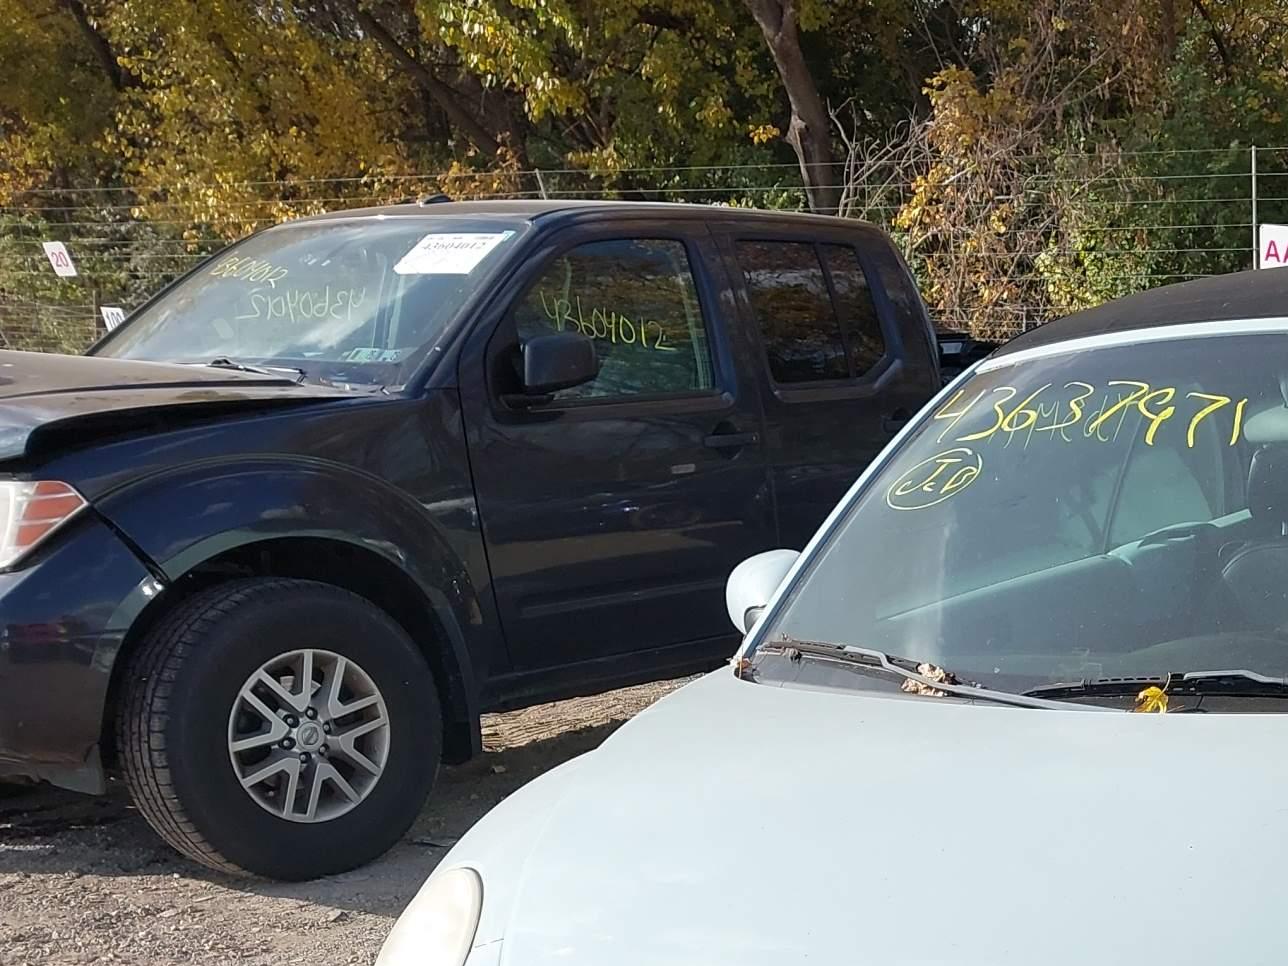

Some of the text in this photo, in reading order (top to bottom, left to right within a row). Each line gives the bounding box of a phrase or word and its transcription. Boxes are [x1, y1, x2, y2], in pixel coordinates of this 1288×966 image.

[51, 251, 69, 268] 20
[539, 290, 678, 350] 43604012
[934, 380, 1249, 449] 43637971
